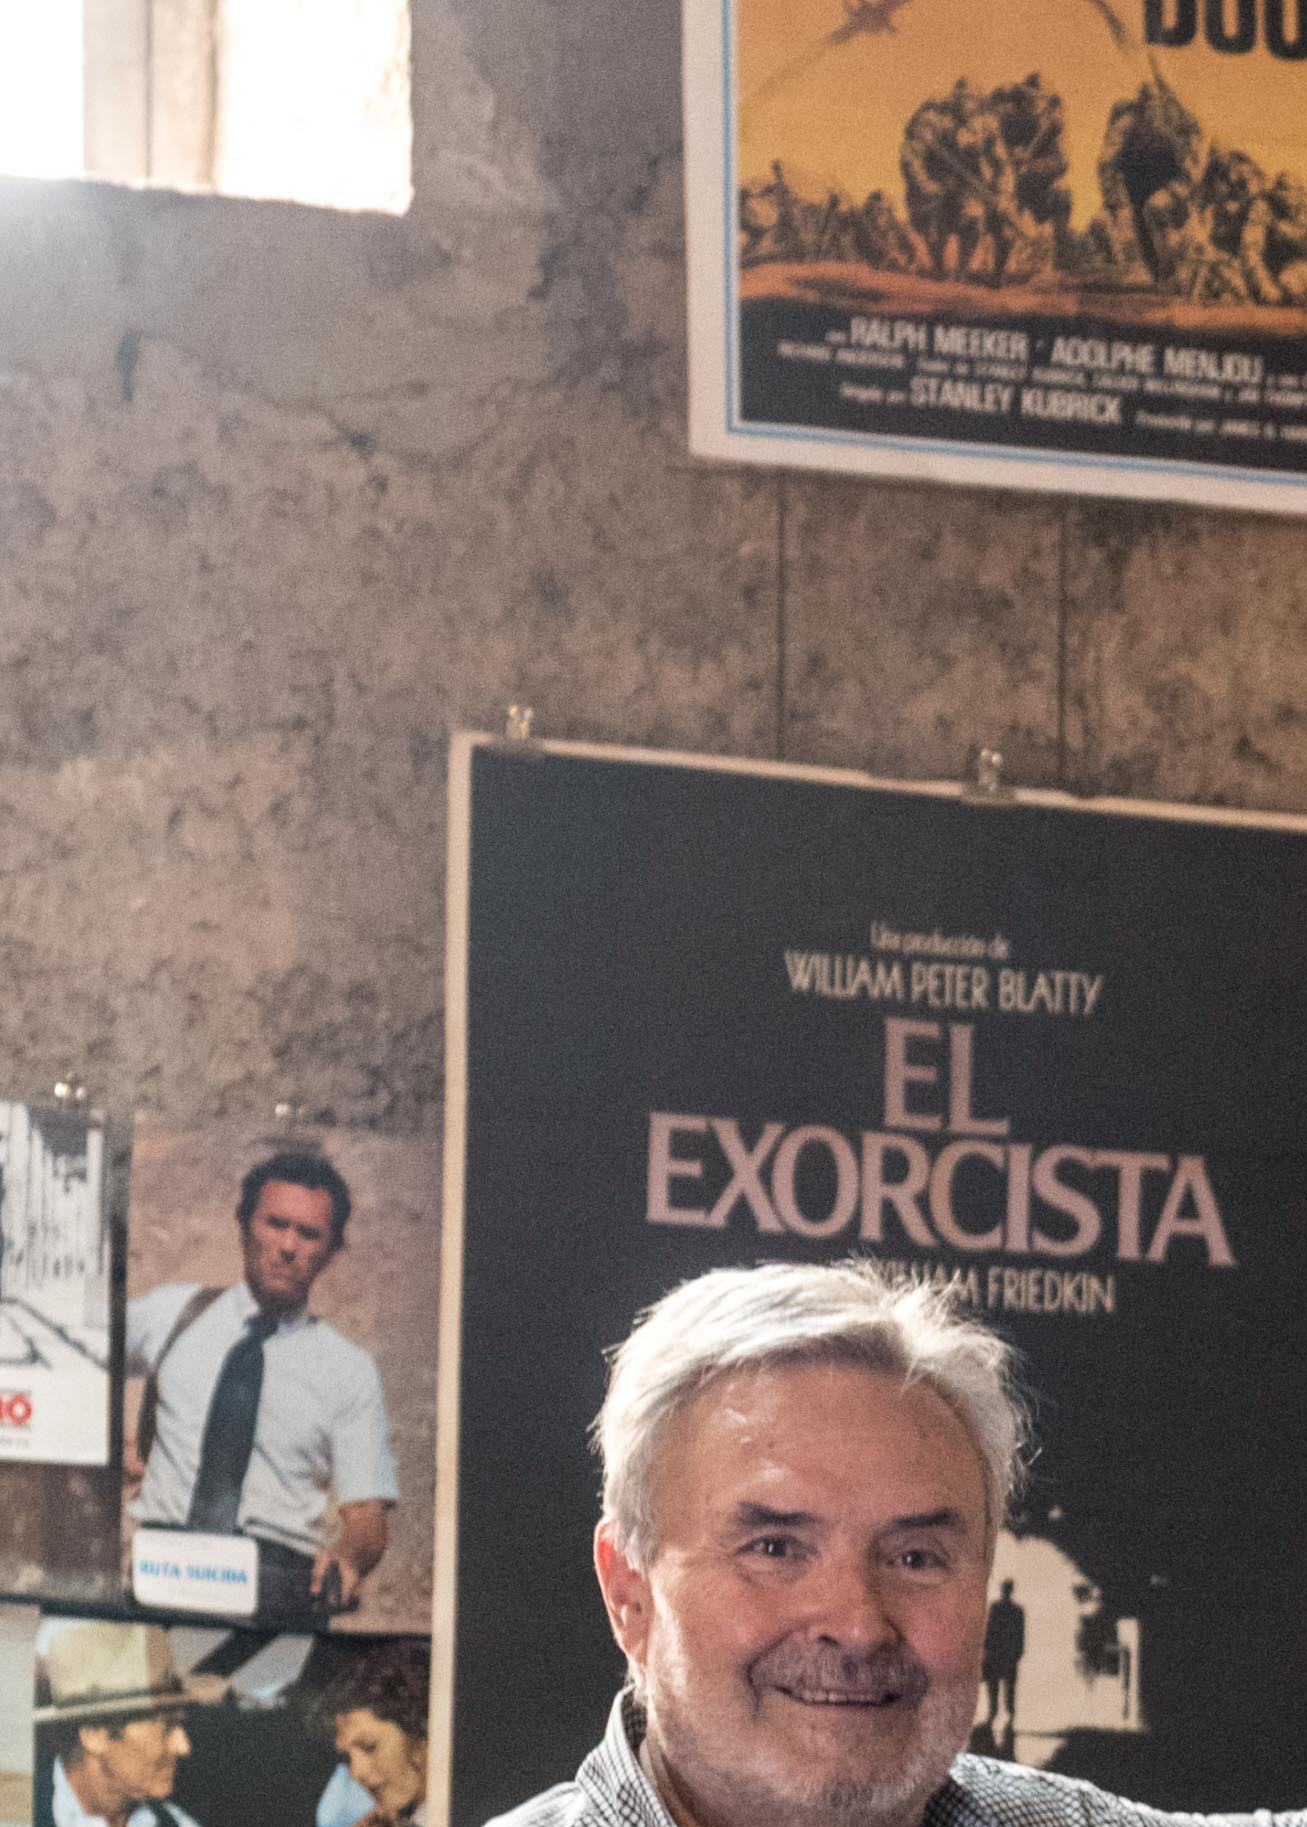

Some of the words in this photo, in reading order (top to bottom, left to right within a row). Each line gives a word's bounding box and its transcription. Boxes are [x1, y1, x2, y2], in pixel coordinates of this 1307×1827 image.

[850, 316, 927, 351] RALPH
[933, 324, 1029, 361] MEEKER
[1050, 335, 1155, 373] ADOLPHE
[1163, 346, 1264, 384] MENJOU
[909, 375, 1014, 413] STANLEY
[1020, 386, 1123, 425] KUBRICK
[784, 949, 902, 1000] WILLIAM
[910, 960, 991, 1010] PETER
[998, 967, 1104, 1015] BLATTY
[883, 1017, 1010, 1137] EL
[645, 1110, 1238, 1269] EXORCISTA
[988, 1267, 1115, 1314] FRIEDKIN
